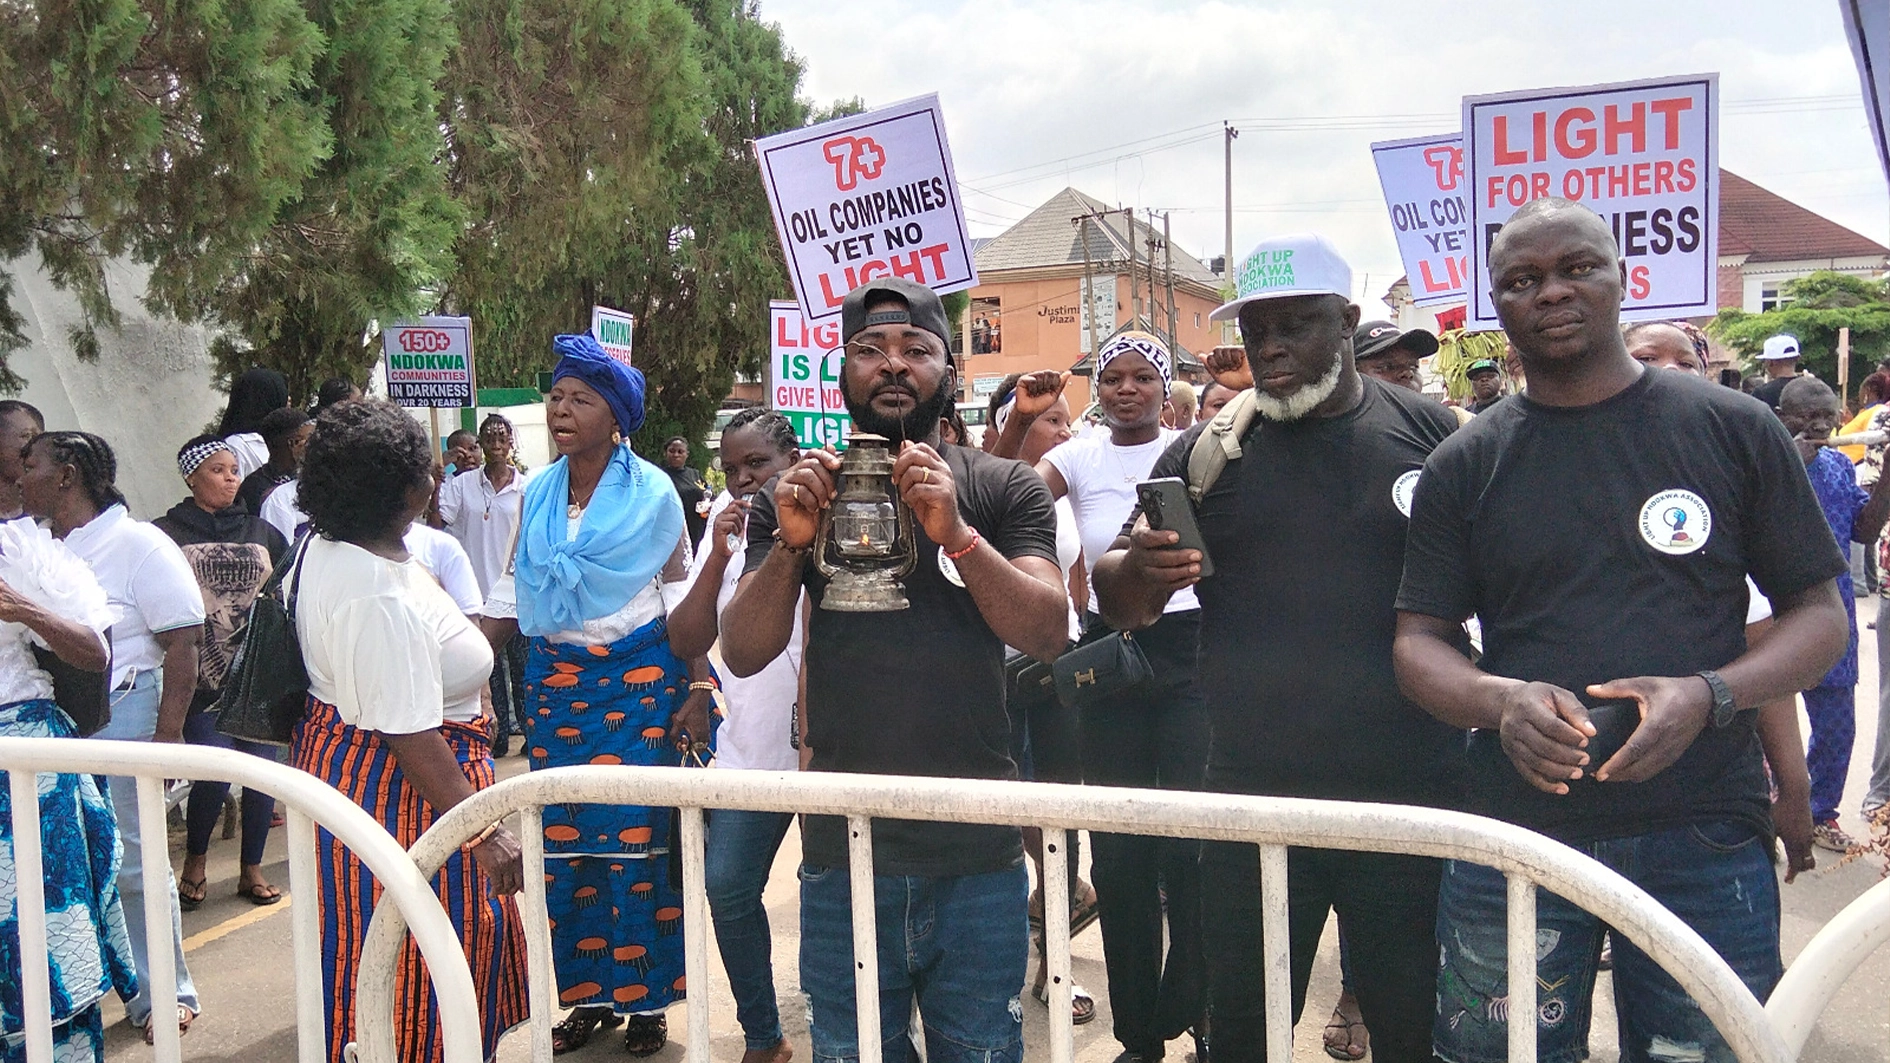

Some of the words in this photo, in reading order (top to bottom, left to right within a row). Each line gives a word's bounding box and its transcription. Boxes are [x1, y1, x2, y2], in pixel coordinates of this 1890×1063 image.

[1492, 97, 1693, 167] LIGHT
[823, 136, 886, 192] 7+
[1487, 172, 1550, 209] FOR
[1563, 158, 1697, 202] OTHERS
[790, 208, 828, 244] OIL
[829, 176, 947, 234] COMPANIES
[1392, 201, 1429, 232] OIL
[823, 233, 875, 265] YET
[883, 222, 924, 251] NO
[1272, 250, 1294, 263] UP
[778, 316, 840, 349] LIG
[1049, 315, 1075, 324] Plaza
[399, 330, 451, 353] 150+
[390, 354, 466, 370] NDOKWA
[782, 354, 811, 381] IS
[391, 371, 466, 381] COMMUNITIES
[390, 384, 404, 397] IN
[405, 383, 469, 397] DARKNESS
[417, 399, 429, 407] 20
[430, 399, 463, 407] YEARS
[777, 386, 815, 408] GIVE
[1647, 493, 1679, 511] NDOKWA
[1680, 493, 1709, 533] ASSOCIATION
